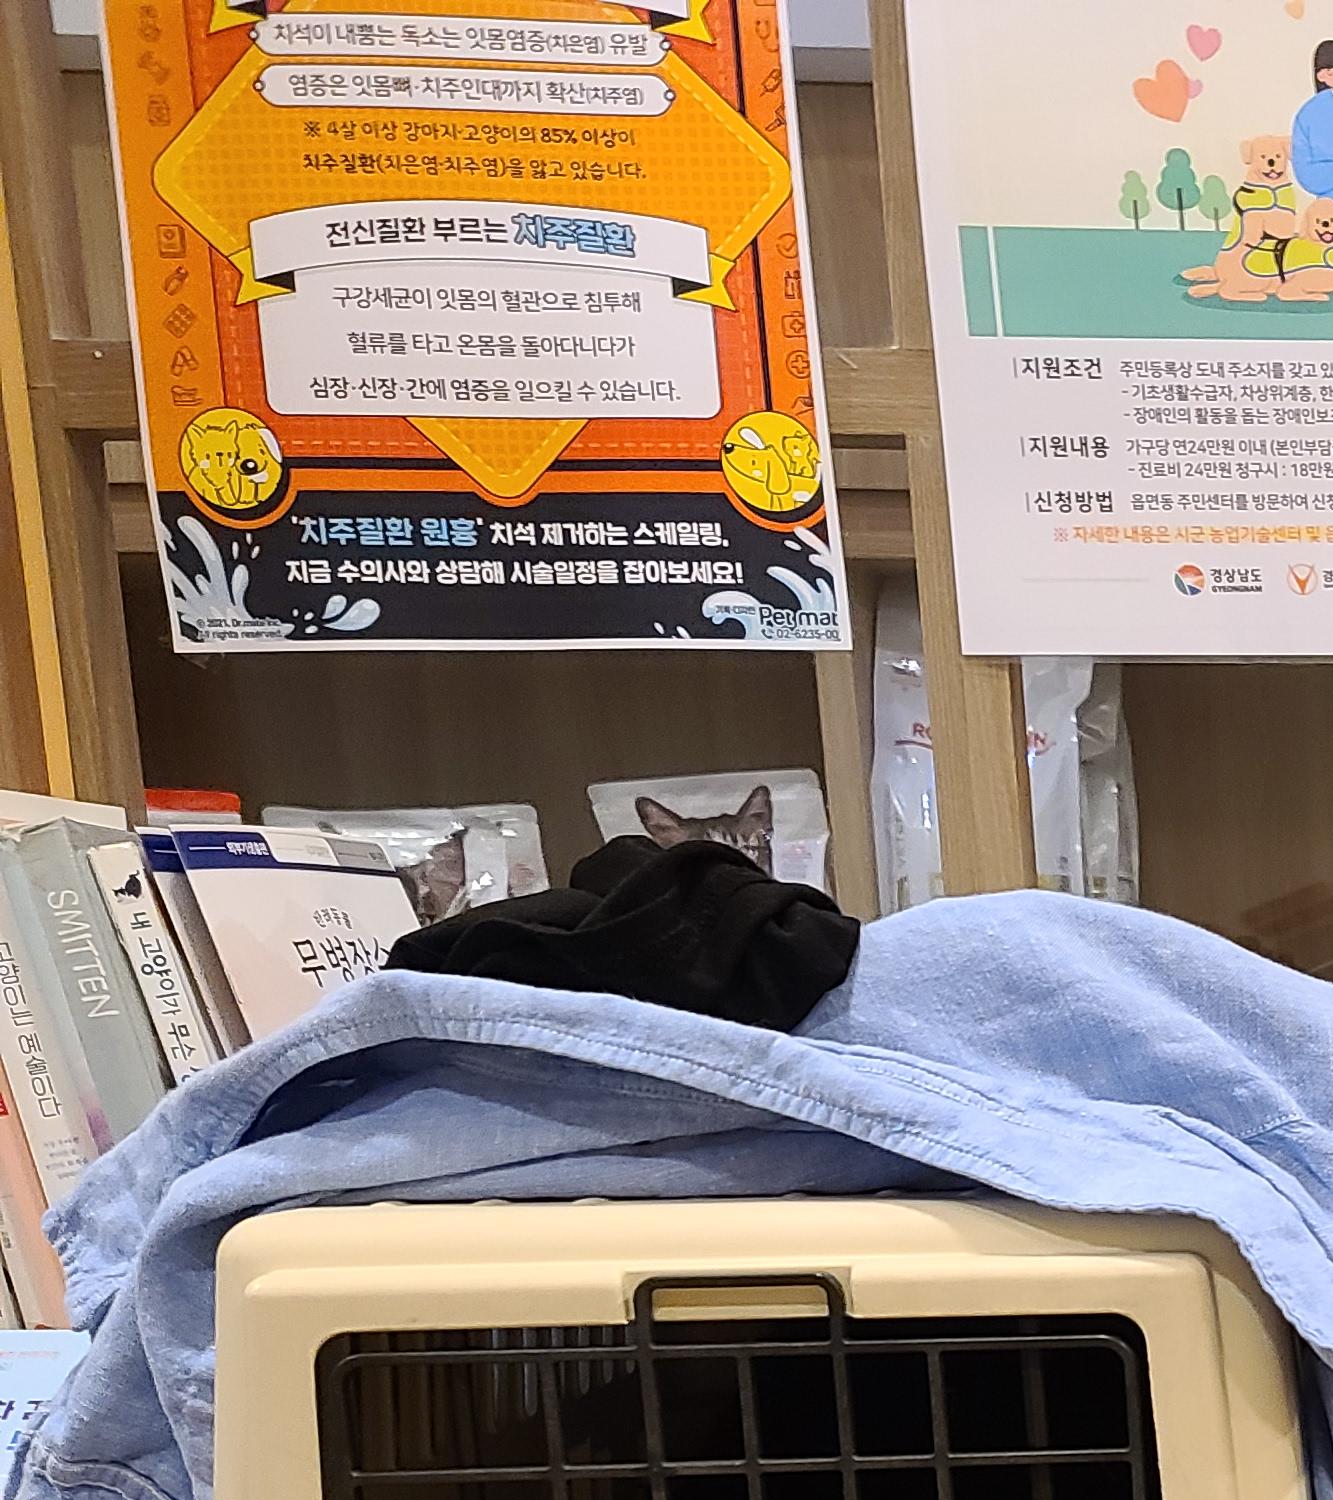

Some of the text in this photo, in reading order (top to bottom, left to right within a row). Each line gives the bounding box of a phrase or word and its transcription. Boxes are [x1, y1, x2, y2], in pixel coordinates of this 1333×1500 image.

[274, 23, 331, 45] 치석이
[401, 24, 461, 48] 독소는
[466, 27, 605, 55] 잇몸염증(치은염)
[608, 33, 648, 56] 유발
[288, 74, 348, 97] 염증은
[546, 82, 644, 105] 확산(치주염)
[325, 212, 637, 258] 전신질환 부르는 치주질환
[332, 287, 642, 314] 구강세균이 잇몸의 혈관으로 침투해
[347, 332, 636, 358] 혈류를 타고 온몸을 돌아다니다가
[1021, 356, 1103, 379] 지원조건
[1120, 360, 1193, 379] 주민등록상
[1196, 361, 1225, 379] 도내
[1228, 362, 1285, 380] 주소지를
[1288, 362, 1318, 380] 갖고
[310, 376, 682, 402] 심장·신장·간에 염증을 일으킬 수 있습니다.
[1133, 407, 1192, 425] 장애인의
[1194, 407, 1238, 425] 활동을
[1241, 407, 1269, 425] 돕는
[1029, 435, 1110, 458] 지원내용
[1126, 438, 1170, 456] 가구당
[1172, 438, 1236, 457] 연24만원
[1239, 439, 1267, 456] 이내
[1034, 490, 1114, 513] 신청방법
[1130, 493, 1174, 511] 읍면동
[1177, 494, 1249, 512] 주민센터를
[1252, 493, 1308, 511] 방문하여
[490, 521, 537, 546] 치석
[541, 522, 628, 546] 제거하는
[633, 521, 729, 548] 스케일링,
[285, 559, 744, 586] 지금 수의사와 상담해 시술일정을 잡아보세요!
[1210, 568, 1263, 583] 경상남도
[47, 888, 121, 1020] SMITTEN
[130, 911, 198, 1061] 내 고양이가 무슨
